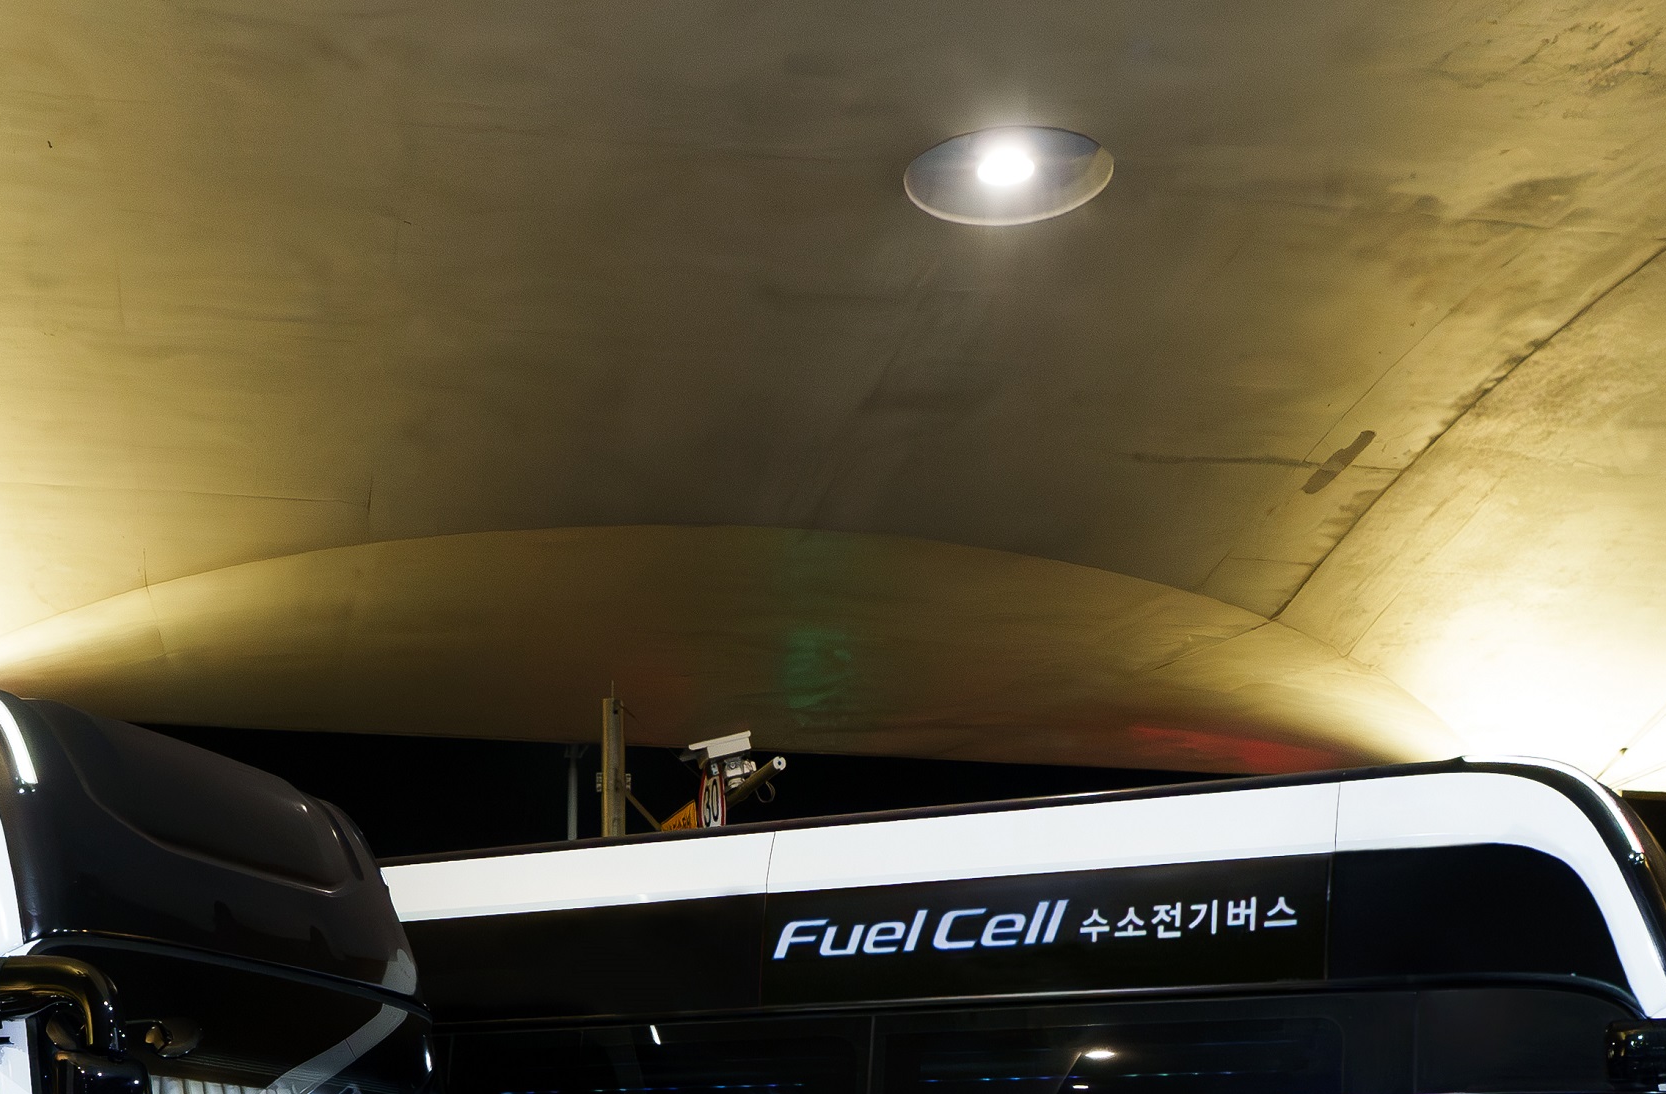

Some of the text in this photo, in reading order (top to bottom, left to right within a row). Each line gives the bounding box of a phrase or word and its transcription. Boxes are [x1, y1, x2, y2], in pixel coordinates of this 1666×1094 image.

[704, 778, 720, 827] 30
[772, 896, 1298, 960] Fuel Cell 수소전기버스
